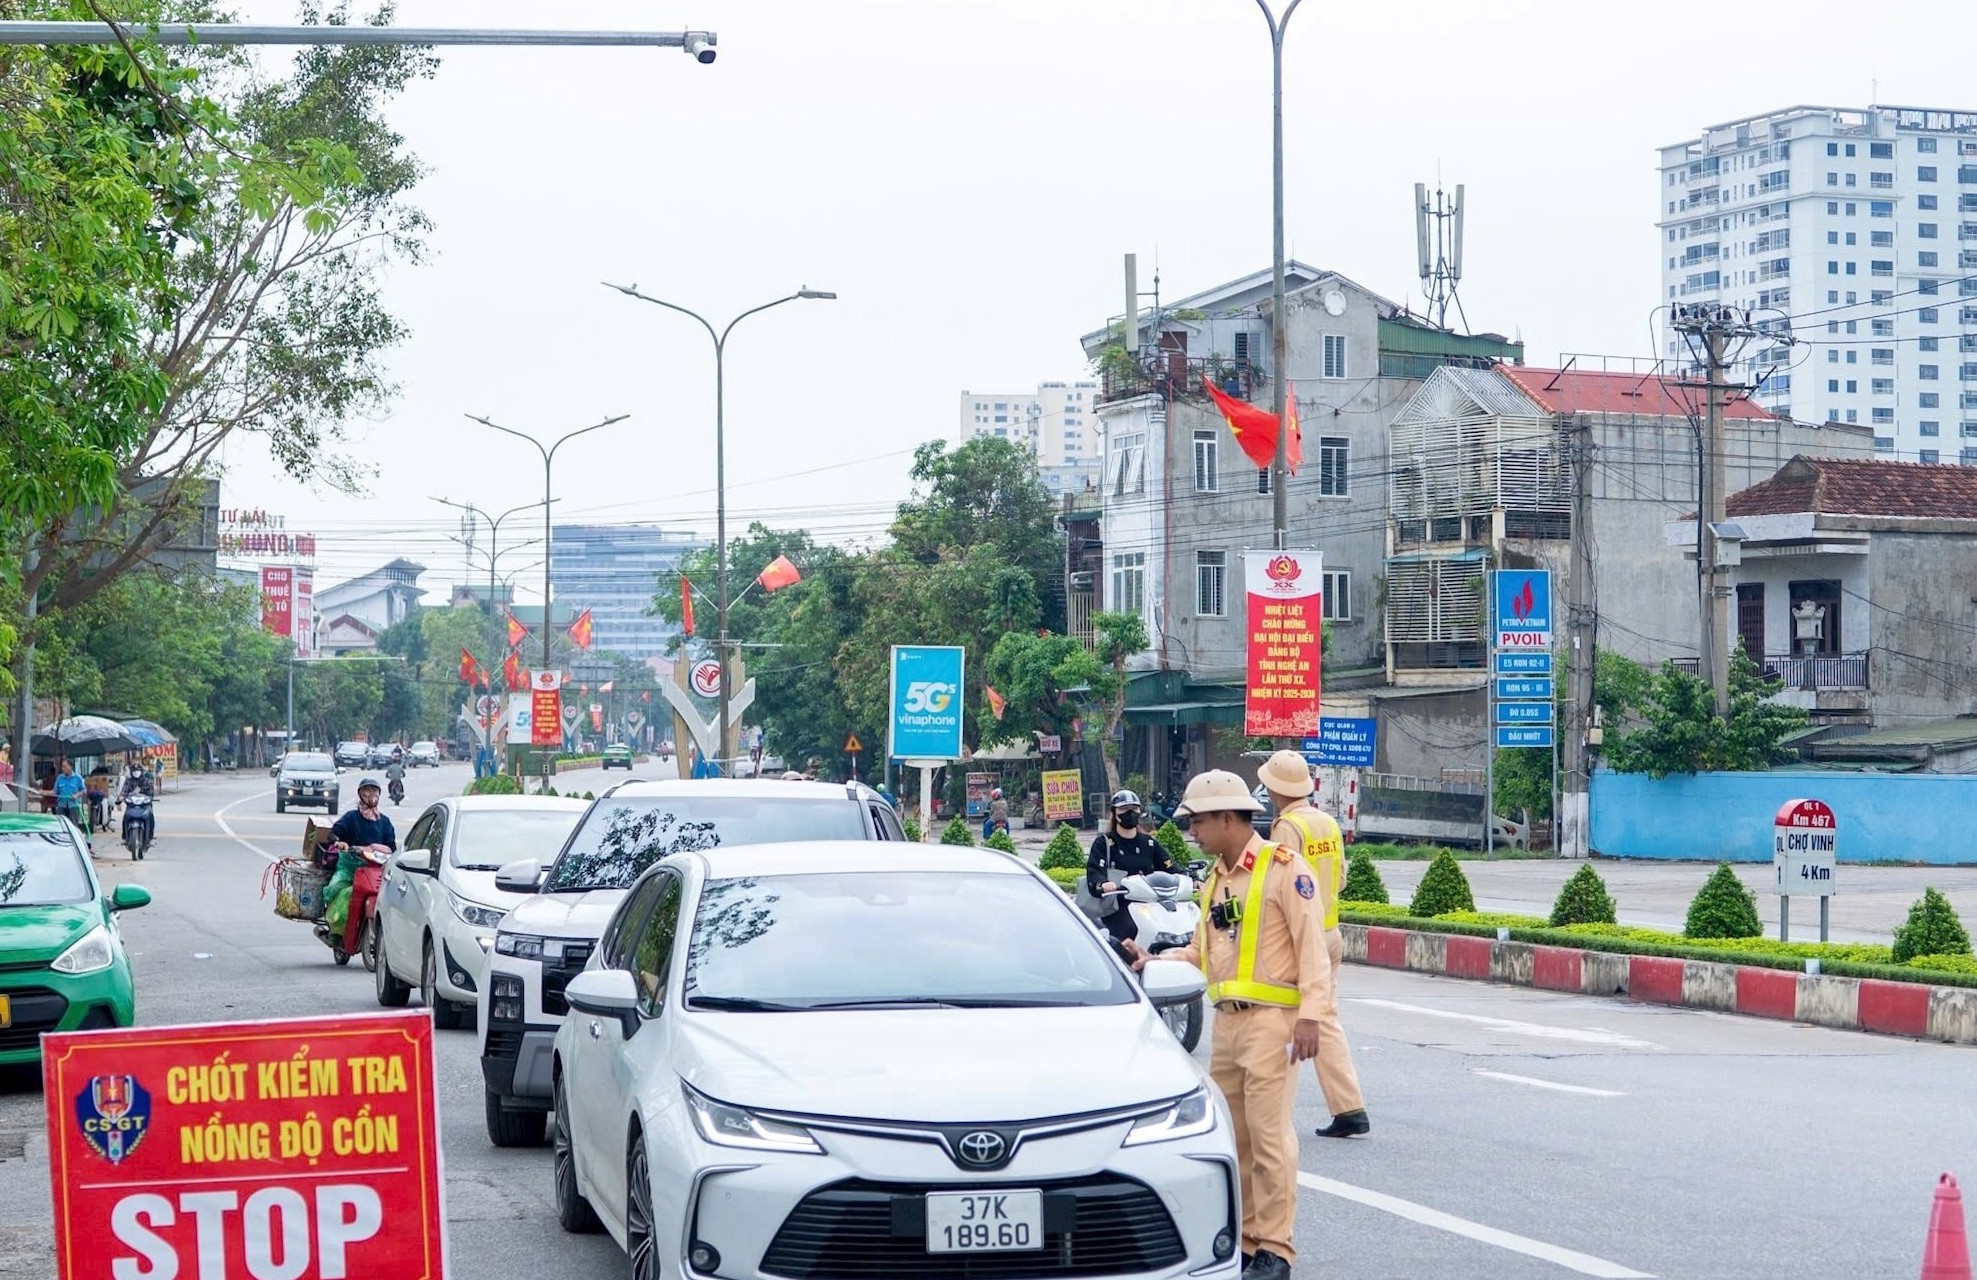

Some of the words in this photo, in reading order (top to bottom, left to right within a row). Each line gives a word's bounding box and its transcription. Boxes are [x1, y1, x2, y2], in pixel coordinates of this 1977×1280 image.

[267, 571, 288, 582] CHO
[264, 583, 290, 597] THUÊ
[1265, 604, 1286, 616] NHIỆT
[1287, 604, 1303, 616] LIỆT
[1262, 618, 1282, 629] CHÀO
[1283, 617, 1306, 629] MỪNG
[1268, 631, 1281, 645] HỘI
[1502, 633, 1546, 645] PVOIL
[1277, 659, 1297, 673] NGHỆ
[1298, 661, 1310, 671] AN
[1503, 659, 1513, 668] E5
[1513, 659, 1528, 668] RON
[1506, 684, 1520, 692] RON
[1521, 684, 1530, 692] 95
[898, 713, 956, 727] vinaphone
[1305, 741, 1320, 750] CÔNG
[1803, 802, 1813, 811] QL
[1815, 802, 1820, 811] 1
[1792, 813, 1809, 826] Km
[1811, 815, 1830, 827] 467
[1776, 836, 1784, 853] QL
[1788, 833, 1809, 853] CHỢ
[1811, 834, 1834, 851] VINH
[1801, 864, 1809, 880] 4
[1811, 865, 1830, 880] Km
[166, 1049, 248, 1106] CHỐT
[257, 1044, 339, 1101] KIỂM
[348, 1054, 408, 1095] TRA
[180, 1110, 270, 1164] NỒNG
[279, 1111, 322, 1166] ĐỘ
[333, 1103, 399, 1155] CỒN
[960, 1195, 1008, 1220] 37K
[110, 1184, 382, 1280] STOP
[944, 1222, 1030, 1249] 189.60
